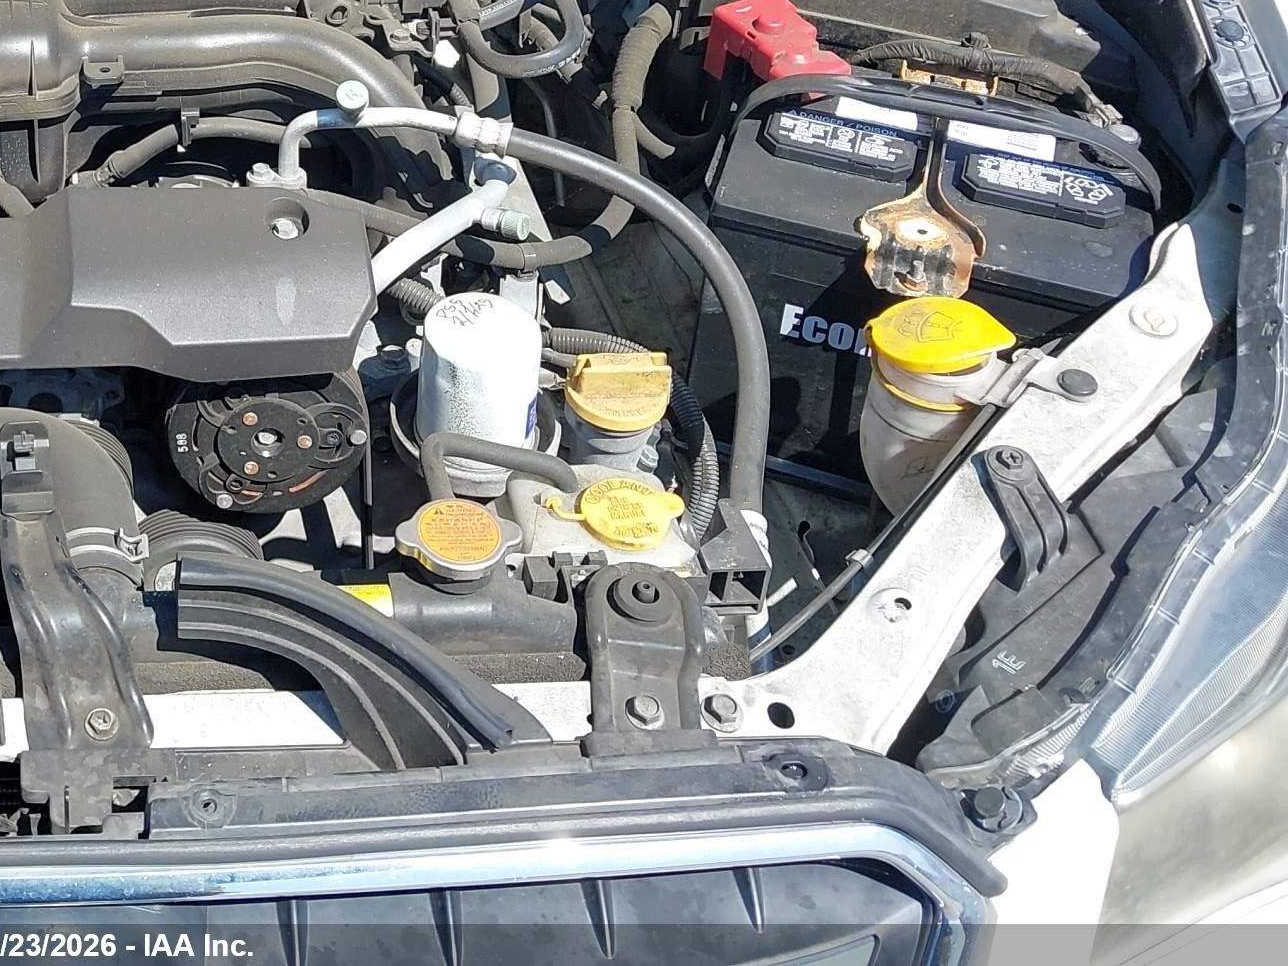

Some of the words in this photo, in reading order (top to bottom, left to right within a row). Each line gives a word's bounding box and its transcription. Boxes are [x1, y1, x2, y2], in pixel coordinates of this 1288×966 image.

[799, 111, 845, 128] DANGER
[855, 123, 898, 138] POISON
[175, 433, 189, 453] 588
[585, 480, 654, 505] COOLANT
